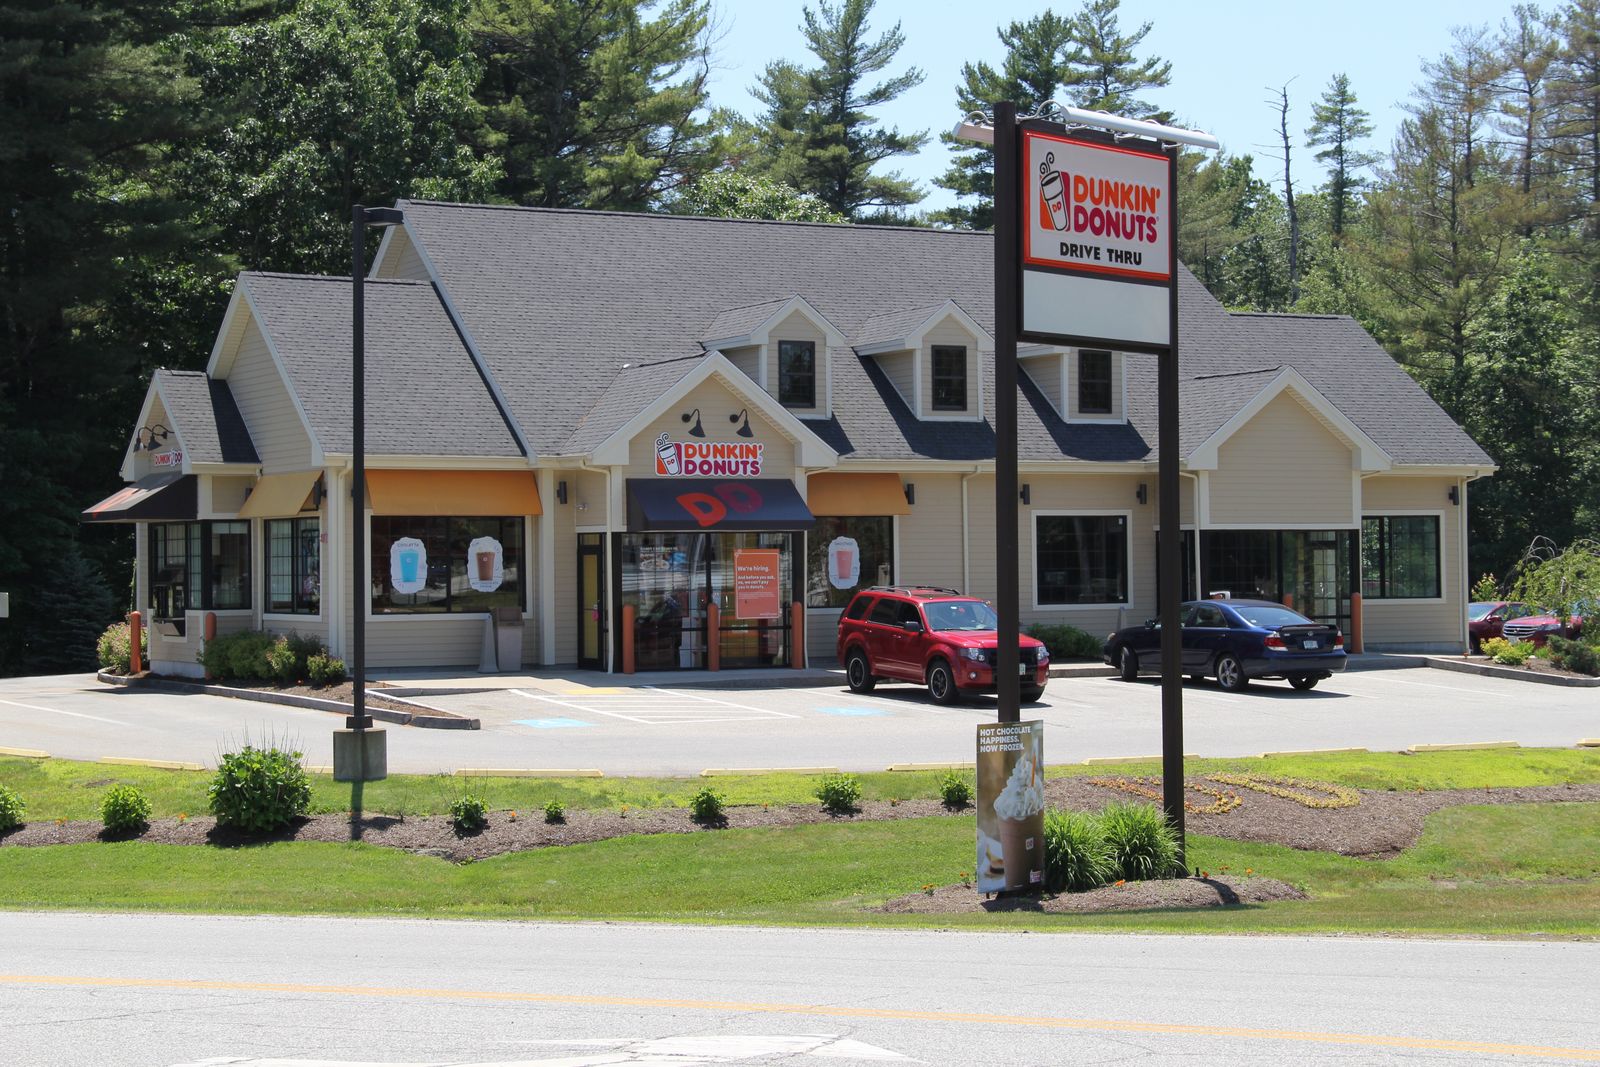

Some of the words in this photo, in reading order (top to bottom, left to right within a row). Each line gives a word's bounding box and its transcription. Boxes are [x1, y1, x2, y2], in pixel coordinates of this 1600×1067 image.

[1074, 175, 1160, 214] DUNKIN'
[1073, 205, 1158, 244] DONUTS
[1059, 242, 1101, 261] DRIVE
[1106, 248, 1142, 266] THRU
[684, 443, 763, 459] DUNKIN'
[684, 460, 761, 476] DONUTS
[980, 728, 996, 737] HOT
[996, 726, 1031, 736] CHOCOLATE
[980, 735, 1020, 745] HAPPINESS.
[980, 744, 998, 752] NOW
